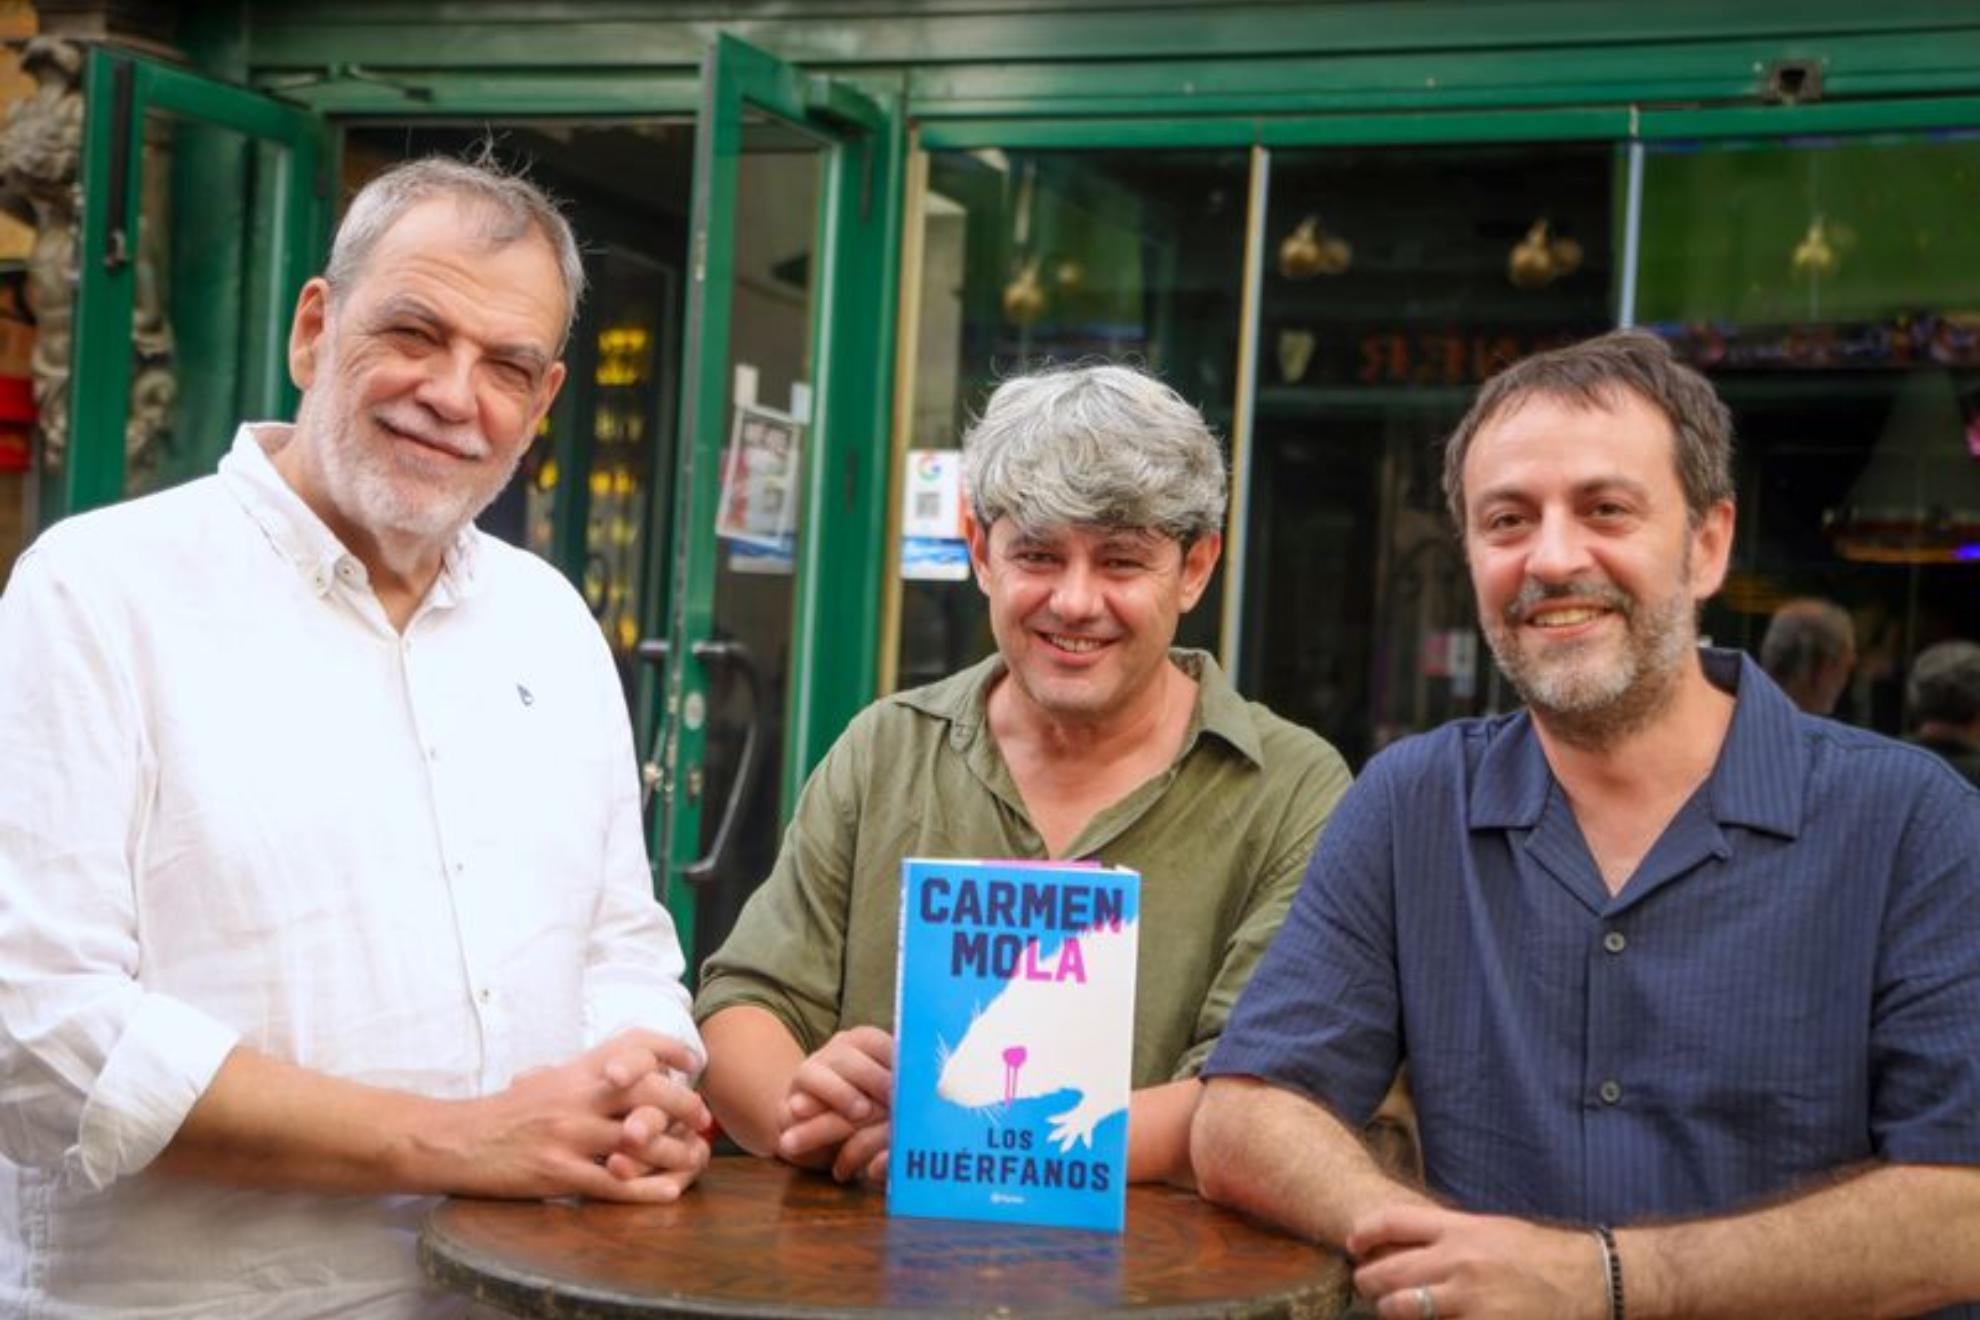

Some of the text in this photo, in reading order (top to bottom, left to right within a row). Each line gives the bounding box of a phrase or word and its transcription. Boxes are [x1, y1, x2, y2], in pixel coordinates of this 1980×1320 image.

[921, 878, 1123, 933] CARMEN
[951, 932, 1086, 983] MOLA
[986, 1127, 1033, 1150] LOS
[906, 1147, 1110, 1191] HUÉRFANOS
